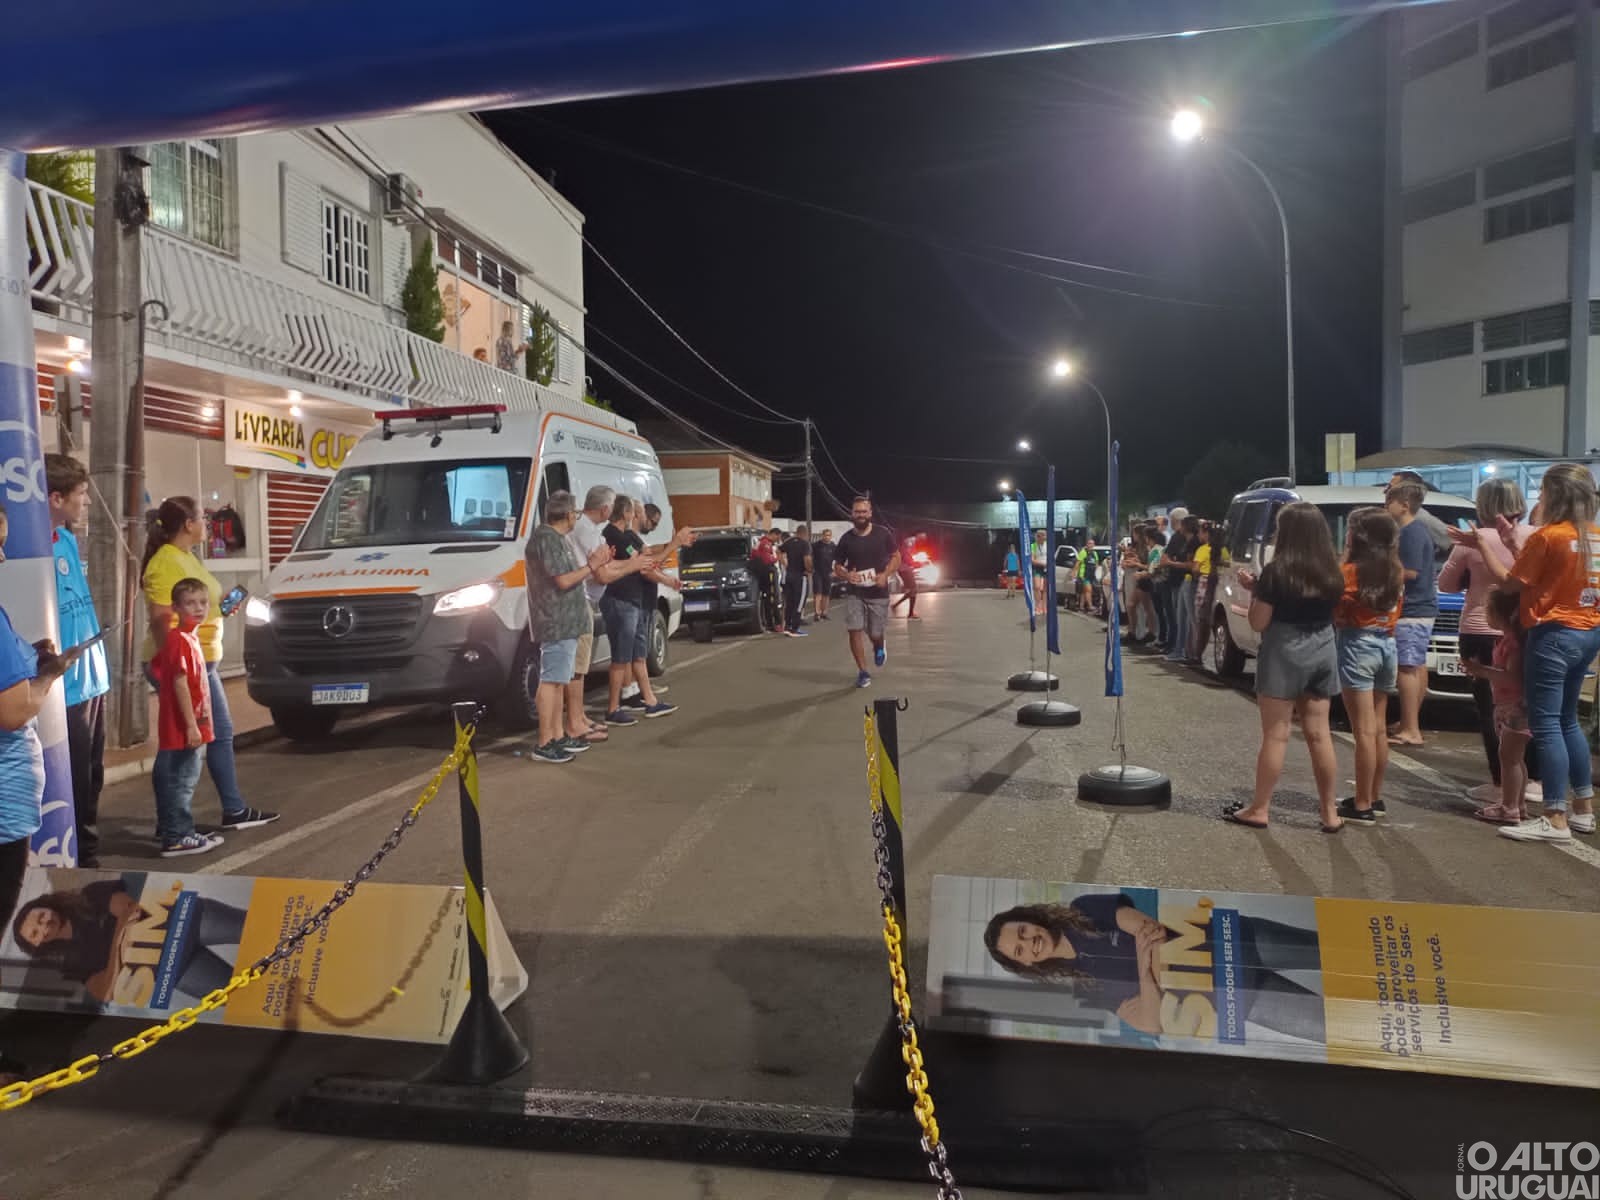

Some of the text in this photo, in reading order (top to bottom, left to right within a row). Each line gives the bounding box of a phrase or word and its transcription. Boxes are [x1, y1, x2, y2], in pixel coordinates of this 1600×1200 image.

[157, 973, 171, 1005] TODOS
[165, 940, 179, 972] PODEM
[273, 983, 286, 1017] pode
[297, 895, 305, 908] os
[280, 896, 295, 940] mundo
[303, 947, 324, 1005] Inclusive
[1222, 914, 1237, 1040] TODOS PODEM SER SESC.
[1369, 917, 1393, 1053] Aqui, todo mundo
[1384, 915, 1410, 1057] pode aproveitar os
[1400, 923, 1422, 1052] serviços do Sesc.
[1427, 933, 1452, 1043] Inclusive você.
